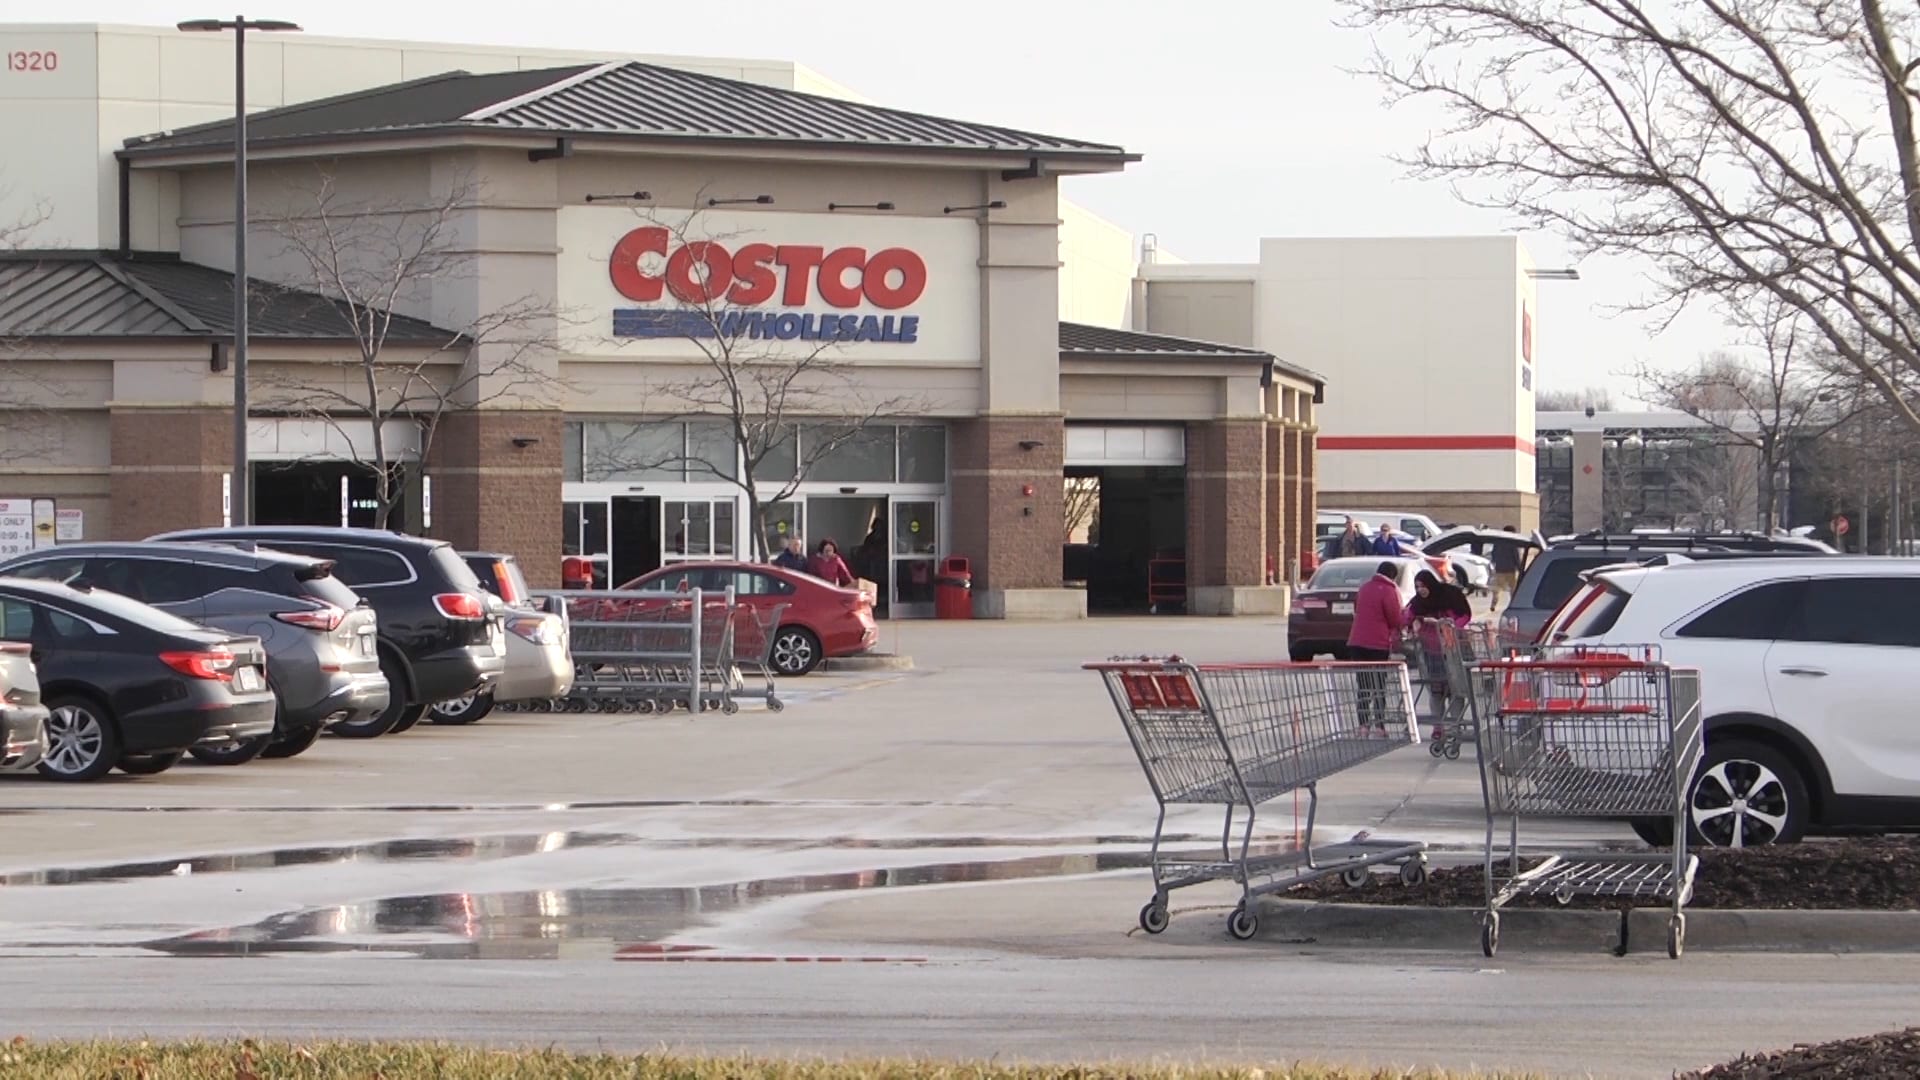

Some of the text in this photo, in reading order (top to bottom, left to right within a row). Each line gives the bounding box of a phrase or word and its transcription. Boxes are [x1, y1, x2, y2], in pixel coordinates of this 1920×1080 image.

[8, 51, 57, 71] 1320
[609, 226, 926, 310] COSTCO
[719, 311, 919, 342] WHOLESALE
[3, 517, 25, 526] ONLY
